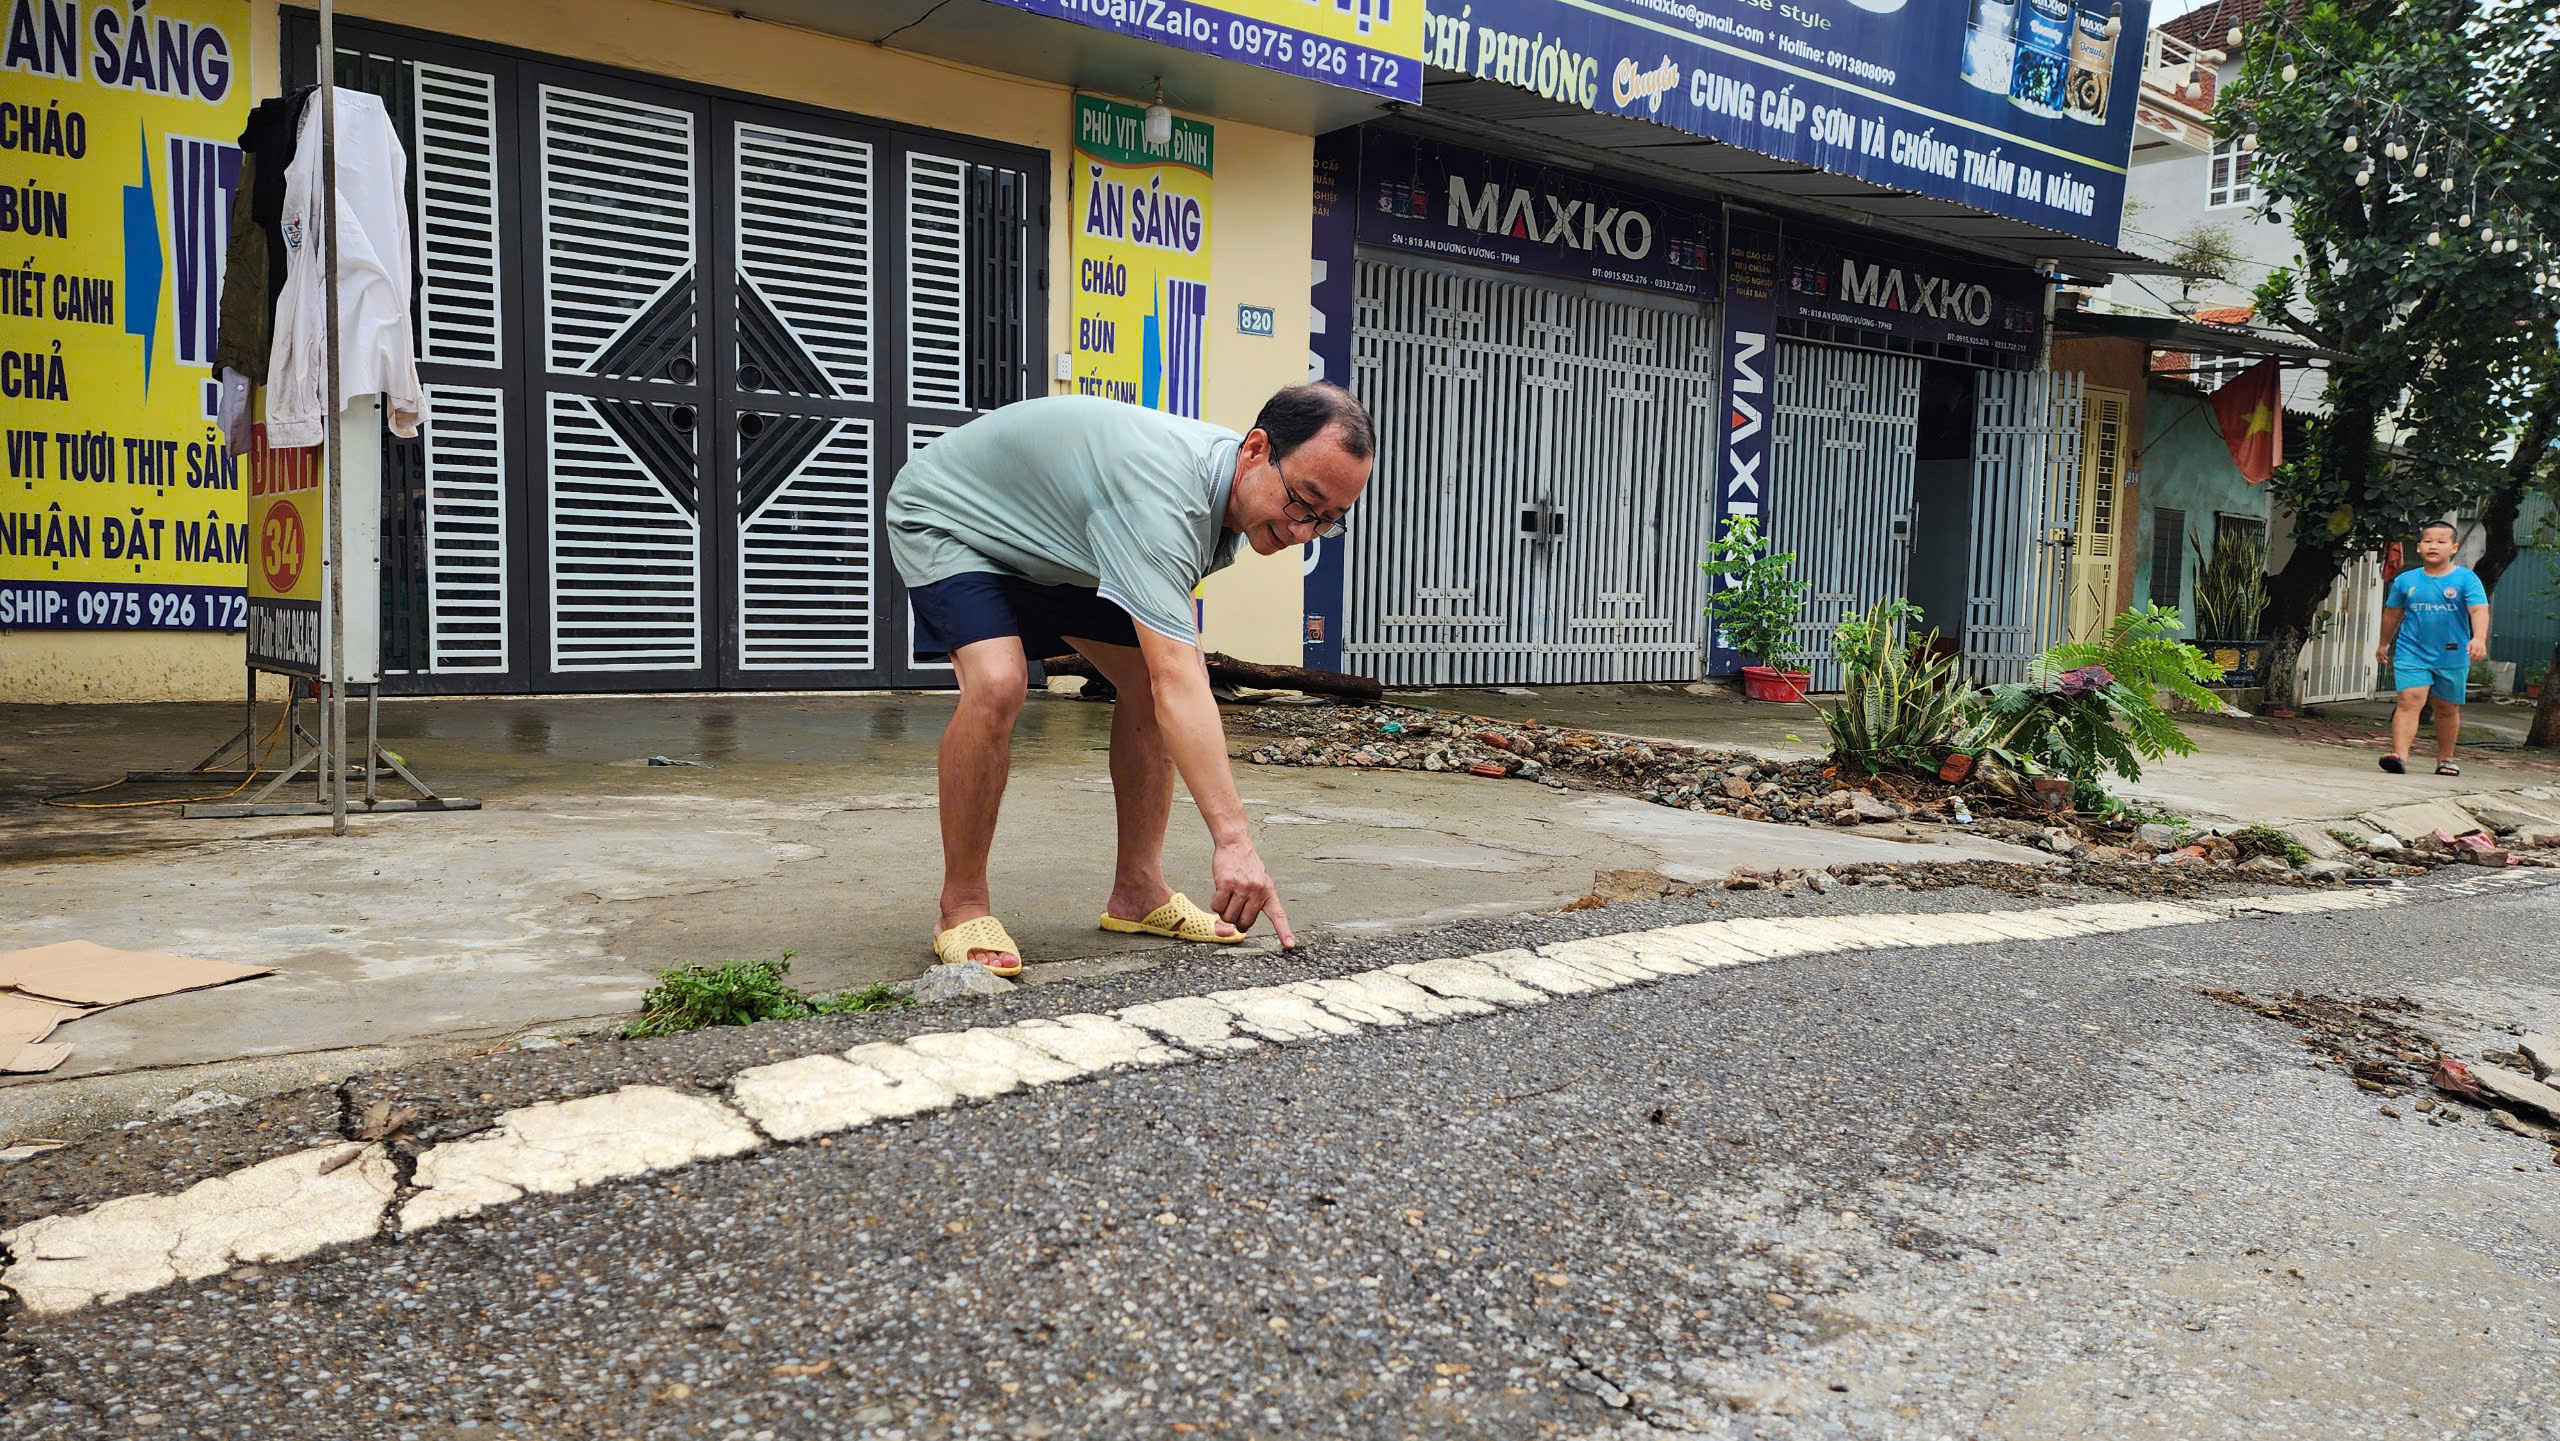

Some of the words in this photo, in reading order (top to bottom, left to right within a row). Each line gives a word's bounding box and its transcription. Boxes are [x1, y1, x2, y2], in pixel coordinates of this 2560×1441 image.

[1779, 4, 1832, 31] style
[2080, 16, 2107, 34] MAXK
[94, 0, 230, 102] SÁNG
[1229, 20, 1292, 62] 0975
[1301, 38, 1347, 75] 926
[1357, 52, 1399, 88] 172
[1779, 34, 1824, 63] Hotline:
[1826, 50, 1896, 86] 0913808099
[2078, 41, 2106, 61] Beauty
[0, 99, 86, 160] CHÁO
[1082, 104, 1112, 146] PHÚ
[1116, 115, 1137, 160] VỊT
[1174, 121, 1207, 166] ĐÌNH
[1423, 4, 1471, 73] CHÍ
[1475, 27, 1598, 109] PHƯƠNG
[1612, 54, 1680, 113] Chuyên
[1690, 68, 1755, 122] CUNG
[1760, 83, 1806, 134] CẤP
[1810, 104, 1857, 150] SƠN
[1860, 116, 1885, 160] VÀ
[1891, 127, 1958, 179] CHỐNG
[1963, 146, 2014, 195] THẤM
[2017, 166, 2041, 202] ĐA
[2045, 172, 2097, 217] NĂNG
[0, 178, 67, 239] BÚN
[1086, 166, 1123, 239] ĂN
[1131, 175, 1201, 252] SÁNG
[1447, 175, 1652, 260] MAXKO
[1081, 255, 1127, 297] CHÁO
[1408, 236, 1423, 247] 818
[1424, 239, 1436, 251] AN
[1437, 241, 1467, 255] DƯƠNG
[1467, 246, 1496, 260] VƯƠNG
[1501, 252, 1520, 264] TPHB
[1603, 270, 1648, 285] 0915.925.276
[0, 256, 46, 318] TIẾT
[53, 273, 114, 325] CANH
[1241, 309, 1272, 331] 820
[1840, 258, 1993, 326] MAXKO
[1080, 312, 1115, 354] BÚN
[1, 339, 69, 401] CHẢ
[7, 430, 48, 490] VỊT
[56, 430, 115, 483] TƯƠI
[123, 438, 178, 497] THỊT
[186, 426, 239, 491] SẴN
[0, 501, 91, 571] NHẬN
[102, 507, 165, 573] ĐẶT
[175, 510, 248, 564] MÂM
[266, 516, 299, 576] 34
[0, 589, 68, 624] SHIP:
[77, 592, 140, 626] 0975
[149, 593, 196, 628] 926
[204, 594, 247, 629] 172
[2409, 602, 2458, 612] ETIHAD
